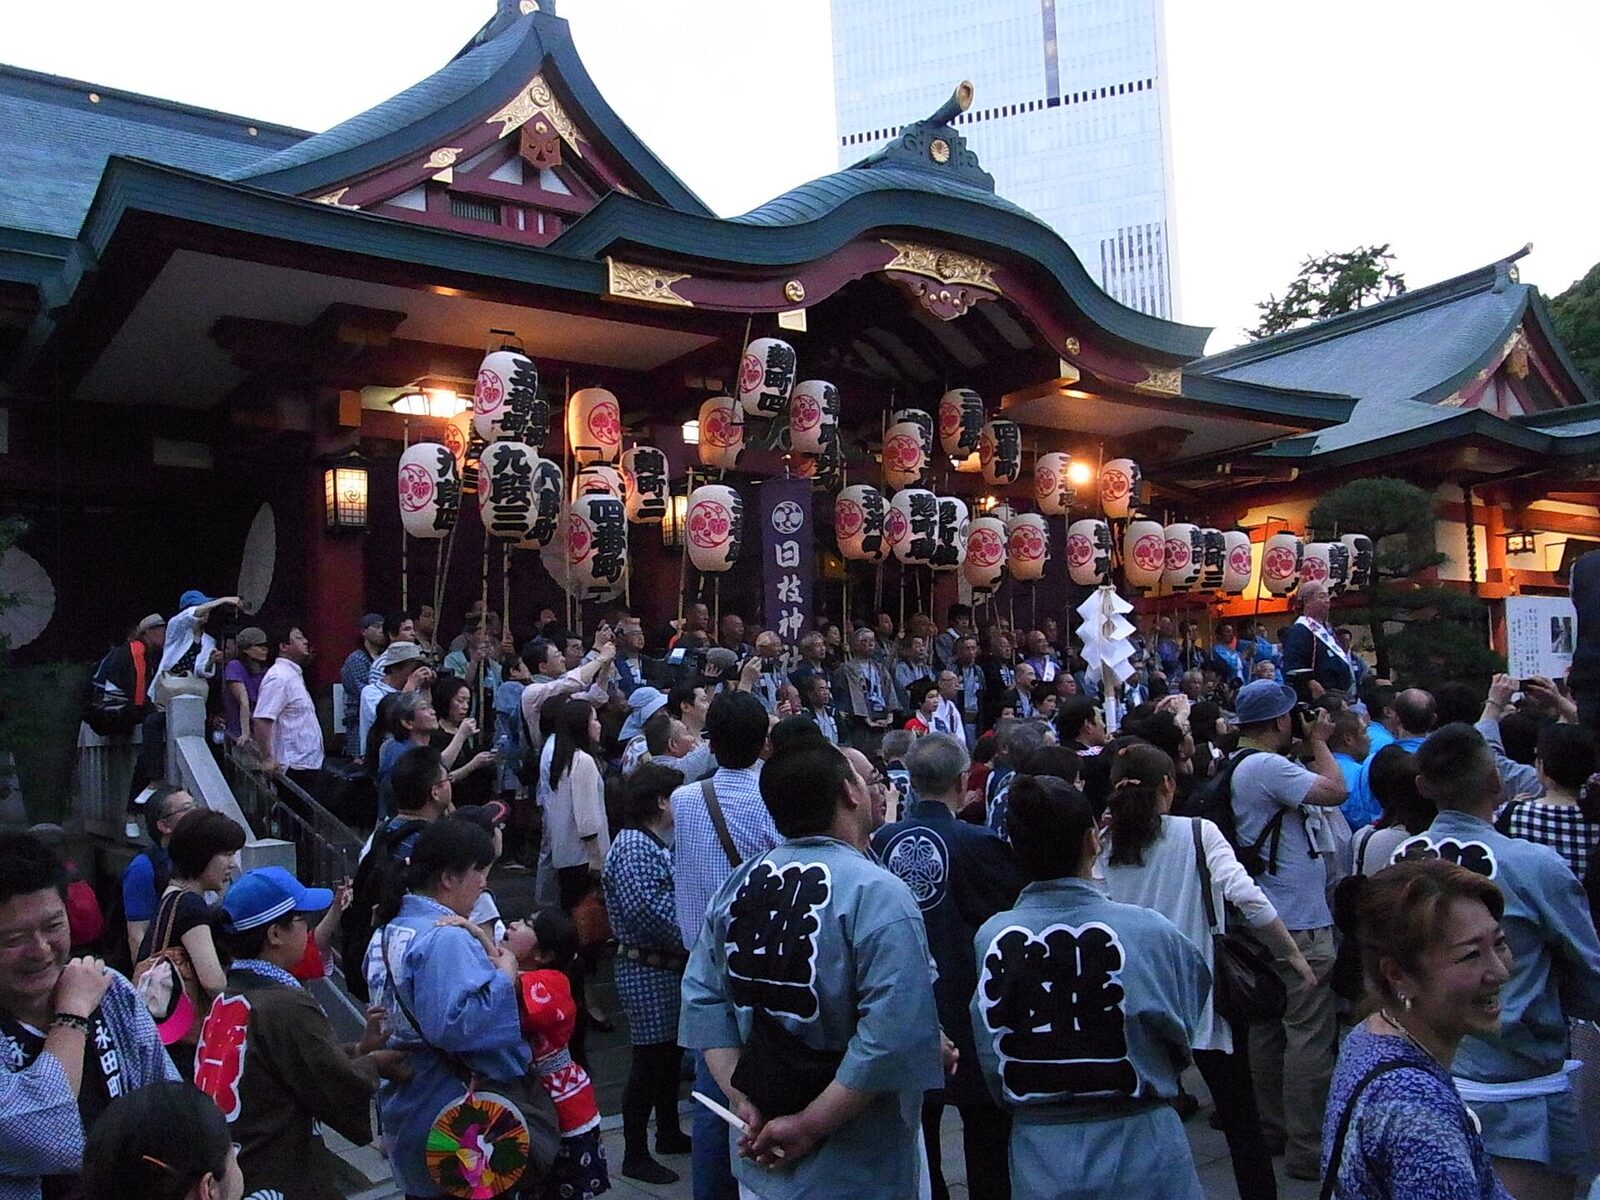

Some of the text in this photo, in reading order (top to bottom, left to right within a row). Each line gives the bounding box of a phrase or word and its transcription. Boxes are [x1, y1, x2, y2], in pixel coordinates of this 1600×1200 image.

[489, 444, 533, 531] 九段三
[587, 499, 626, 584] 四番町
[775, 540, 804, 674] 日枝神社
